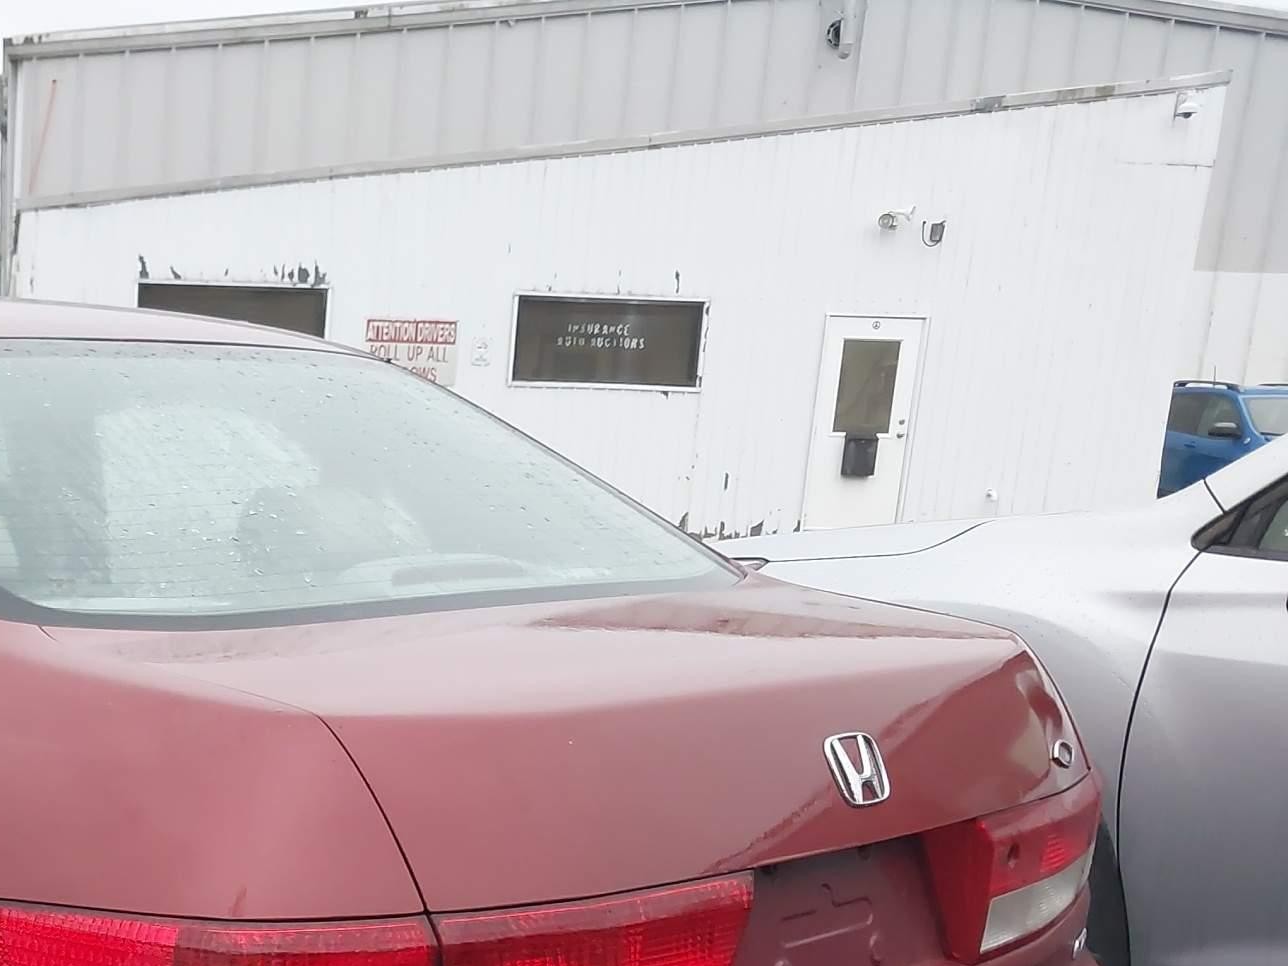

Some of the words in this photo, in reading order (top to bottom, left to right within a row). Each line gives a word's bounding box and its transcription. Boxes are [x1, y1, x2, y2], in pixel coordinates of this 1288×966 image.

[368, 321, 415, 341] ATTENTION
[416, 322, 455, 343] DRIVERS
[407, 345, 423, 362] UP
[427, 345, 448, 363] ALL
